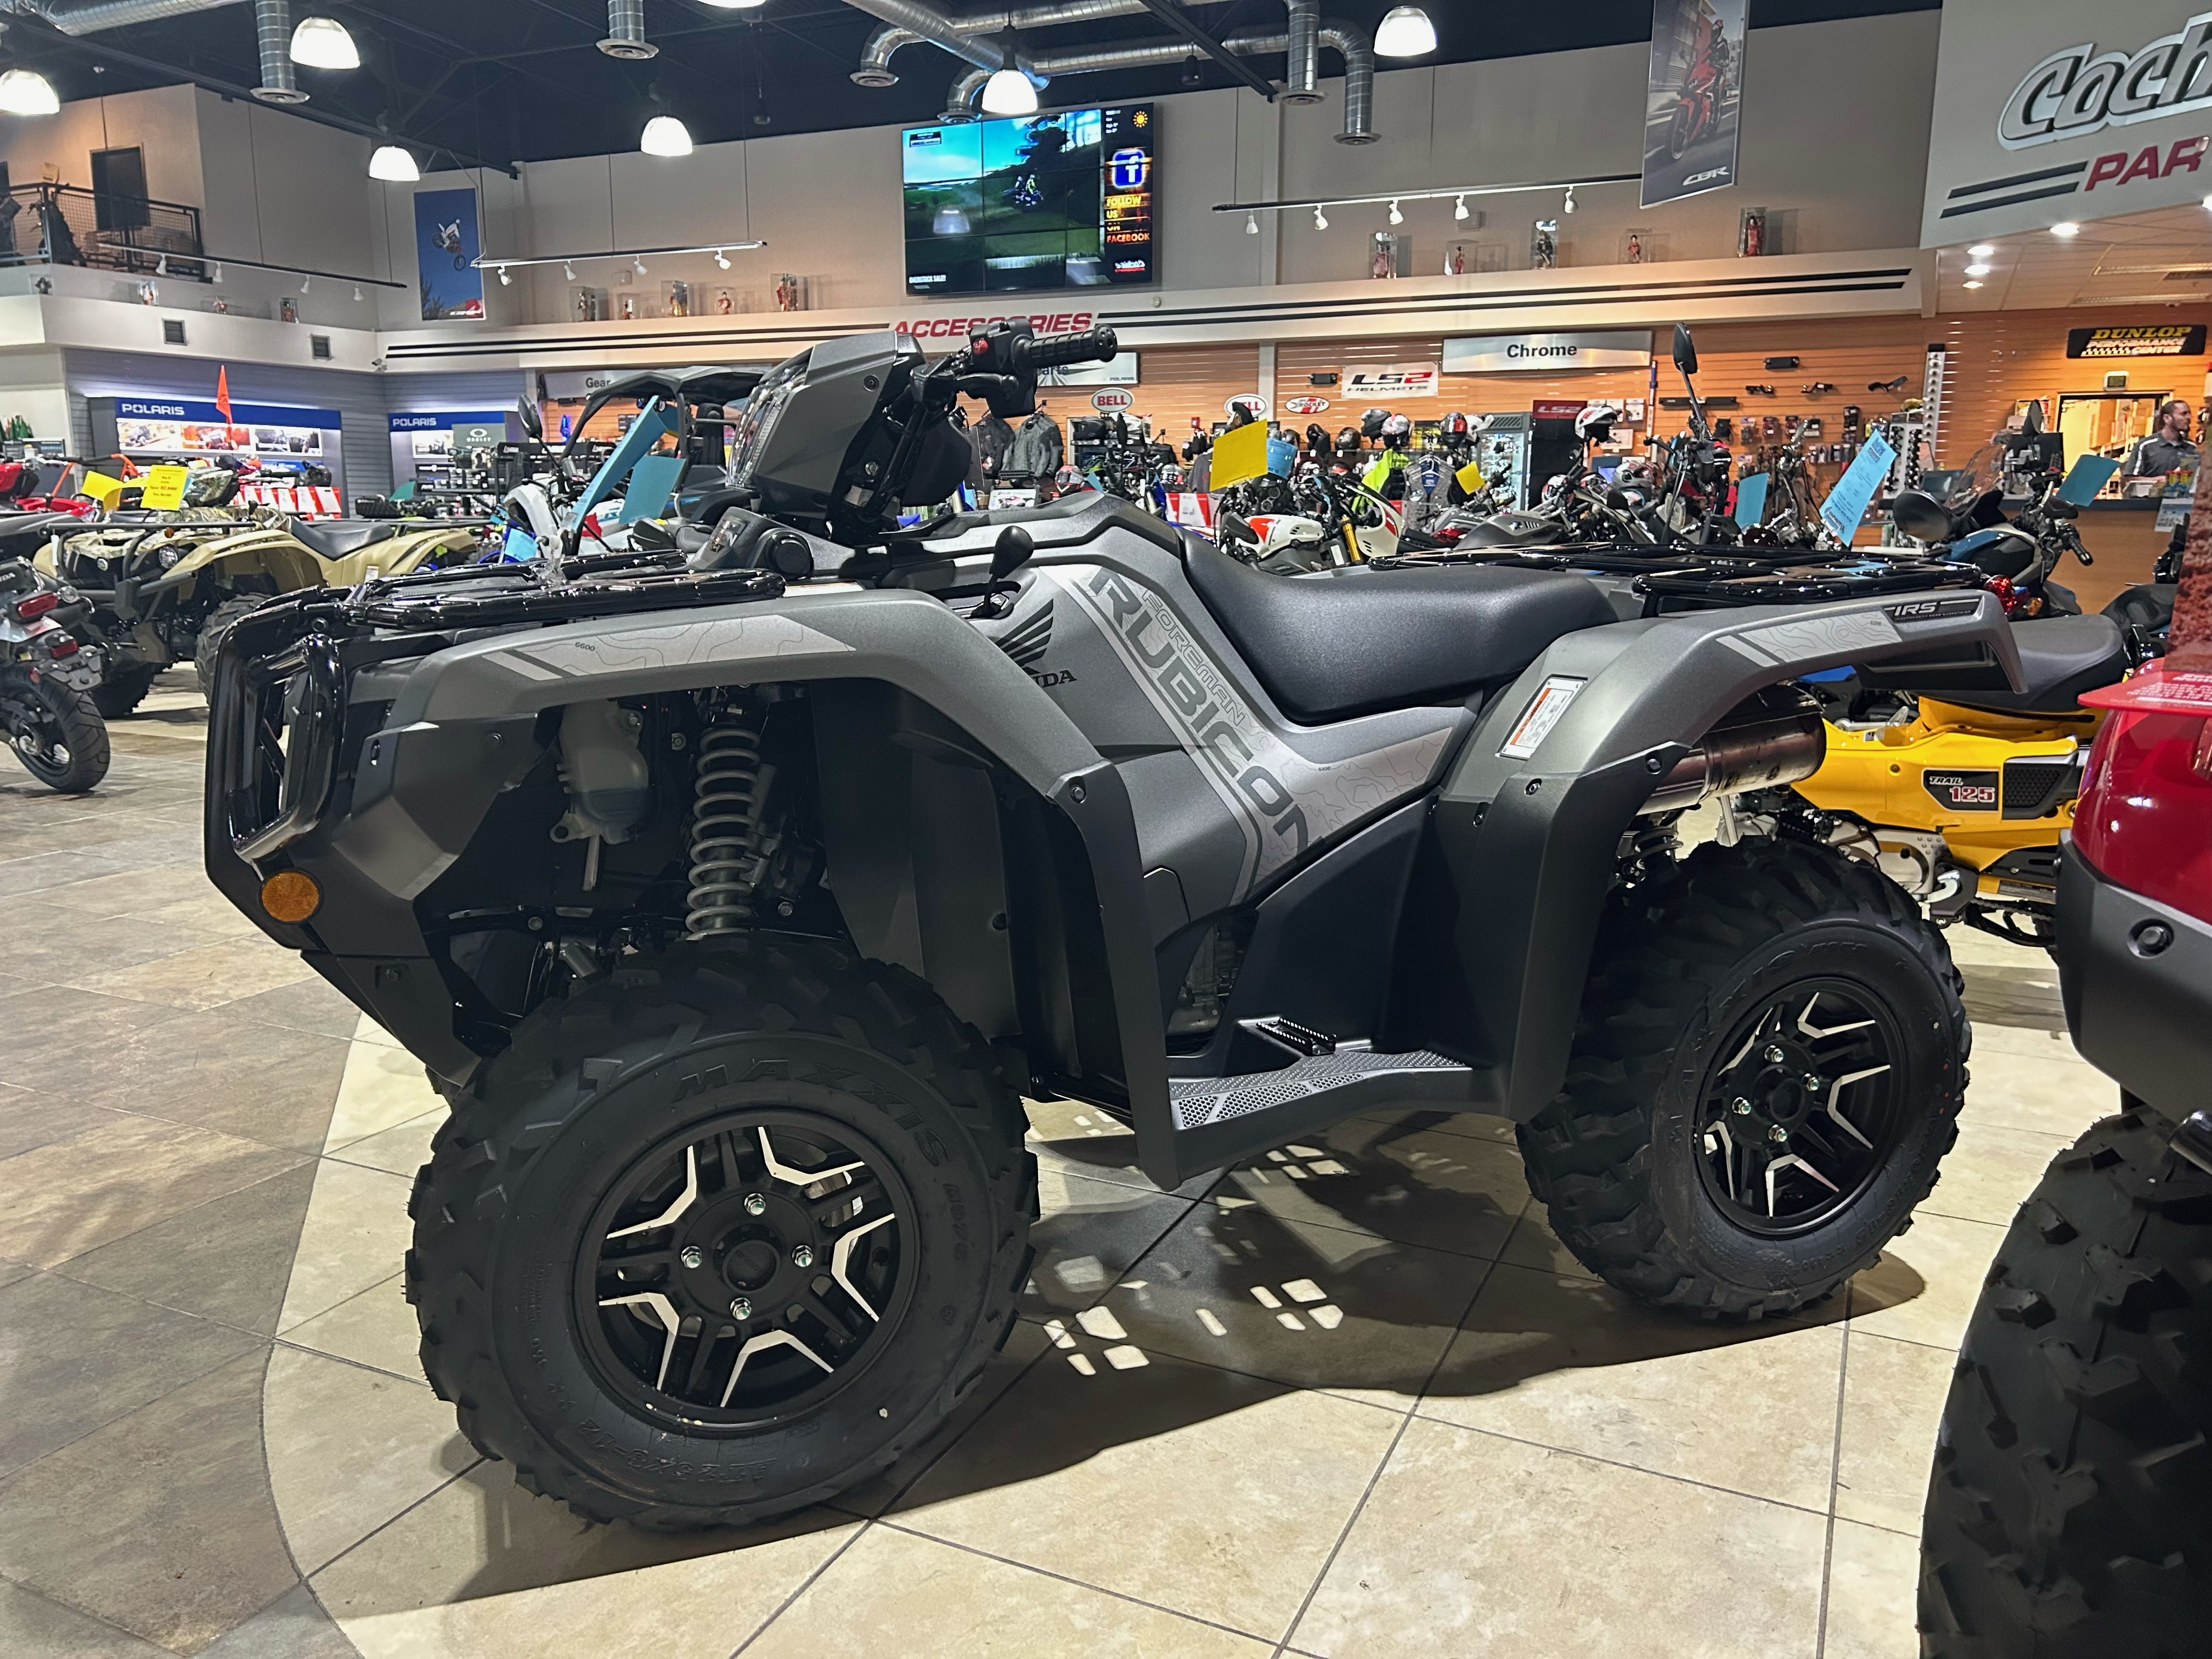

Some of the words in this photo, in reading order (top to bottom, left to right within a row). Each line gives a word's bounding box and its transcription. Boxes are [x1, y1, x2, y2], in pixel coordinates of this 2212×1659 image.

[1683, 166, 1730, 186] CBR
[1106, 195, 1142, 207] FOLLOW
[1106, 210, 1118, 218] US
[1107, 233, 1150, 243] FACEBOOK
[2091, 326, 2192, 339] DUNLOP
[2086, 337, 2187, 348] PERFORMANCE
[1506, 343, 1577, 358] Chrome
[2131, 345, 2182, 354] CENTER
[585, 377, 611, 388] Gear
[1351, 371, 1432, 385] LS2
[1097, 395, 1127, 406] BELL
[121, 403, 185, 416] POLARIS
[1537, 405, 1582, 414] LS2
[392, 417, 437, 427] POLARIS
[1894, 602, 1937, 616] IRS
[574, 641, 595, 652] 6600
[1141, 589, 1245, 725] FOREMAN
[1088, 566, 1309, 859] RUBICON
[1929, 776, 1963, 786] TRAIL
[1949, 786, 1995, 803] 125
[670, 1058, 951, 1167] MAXXIS
